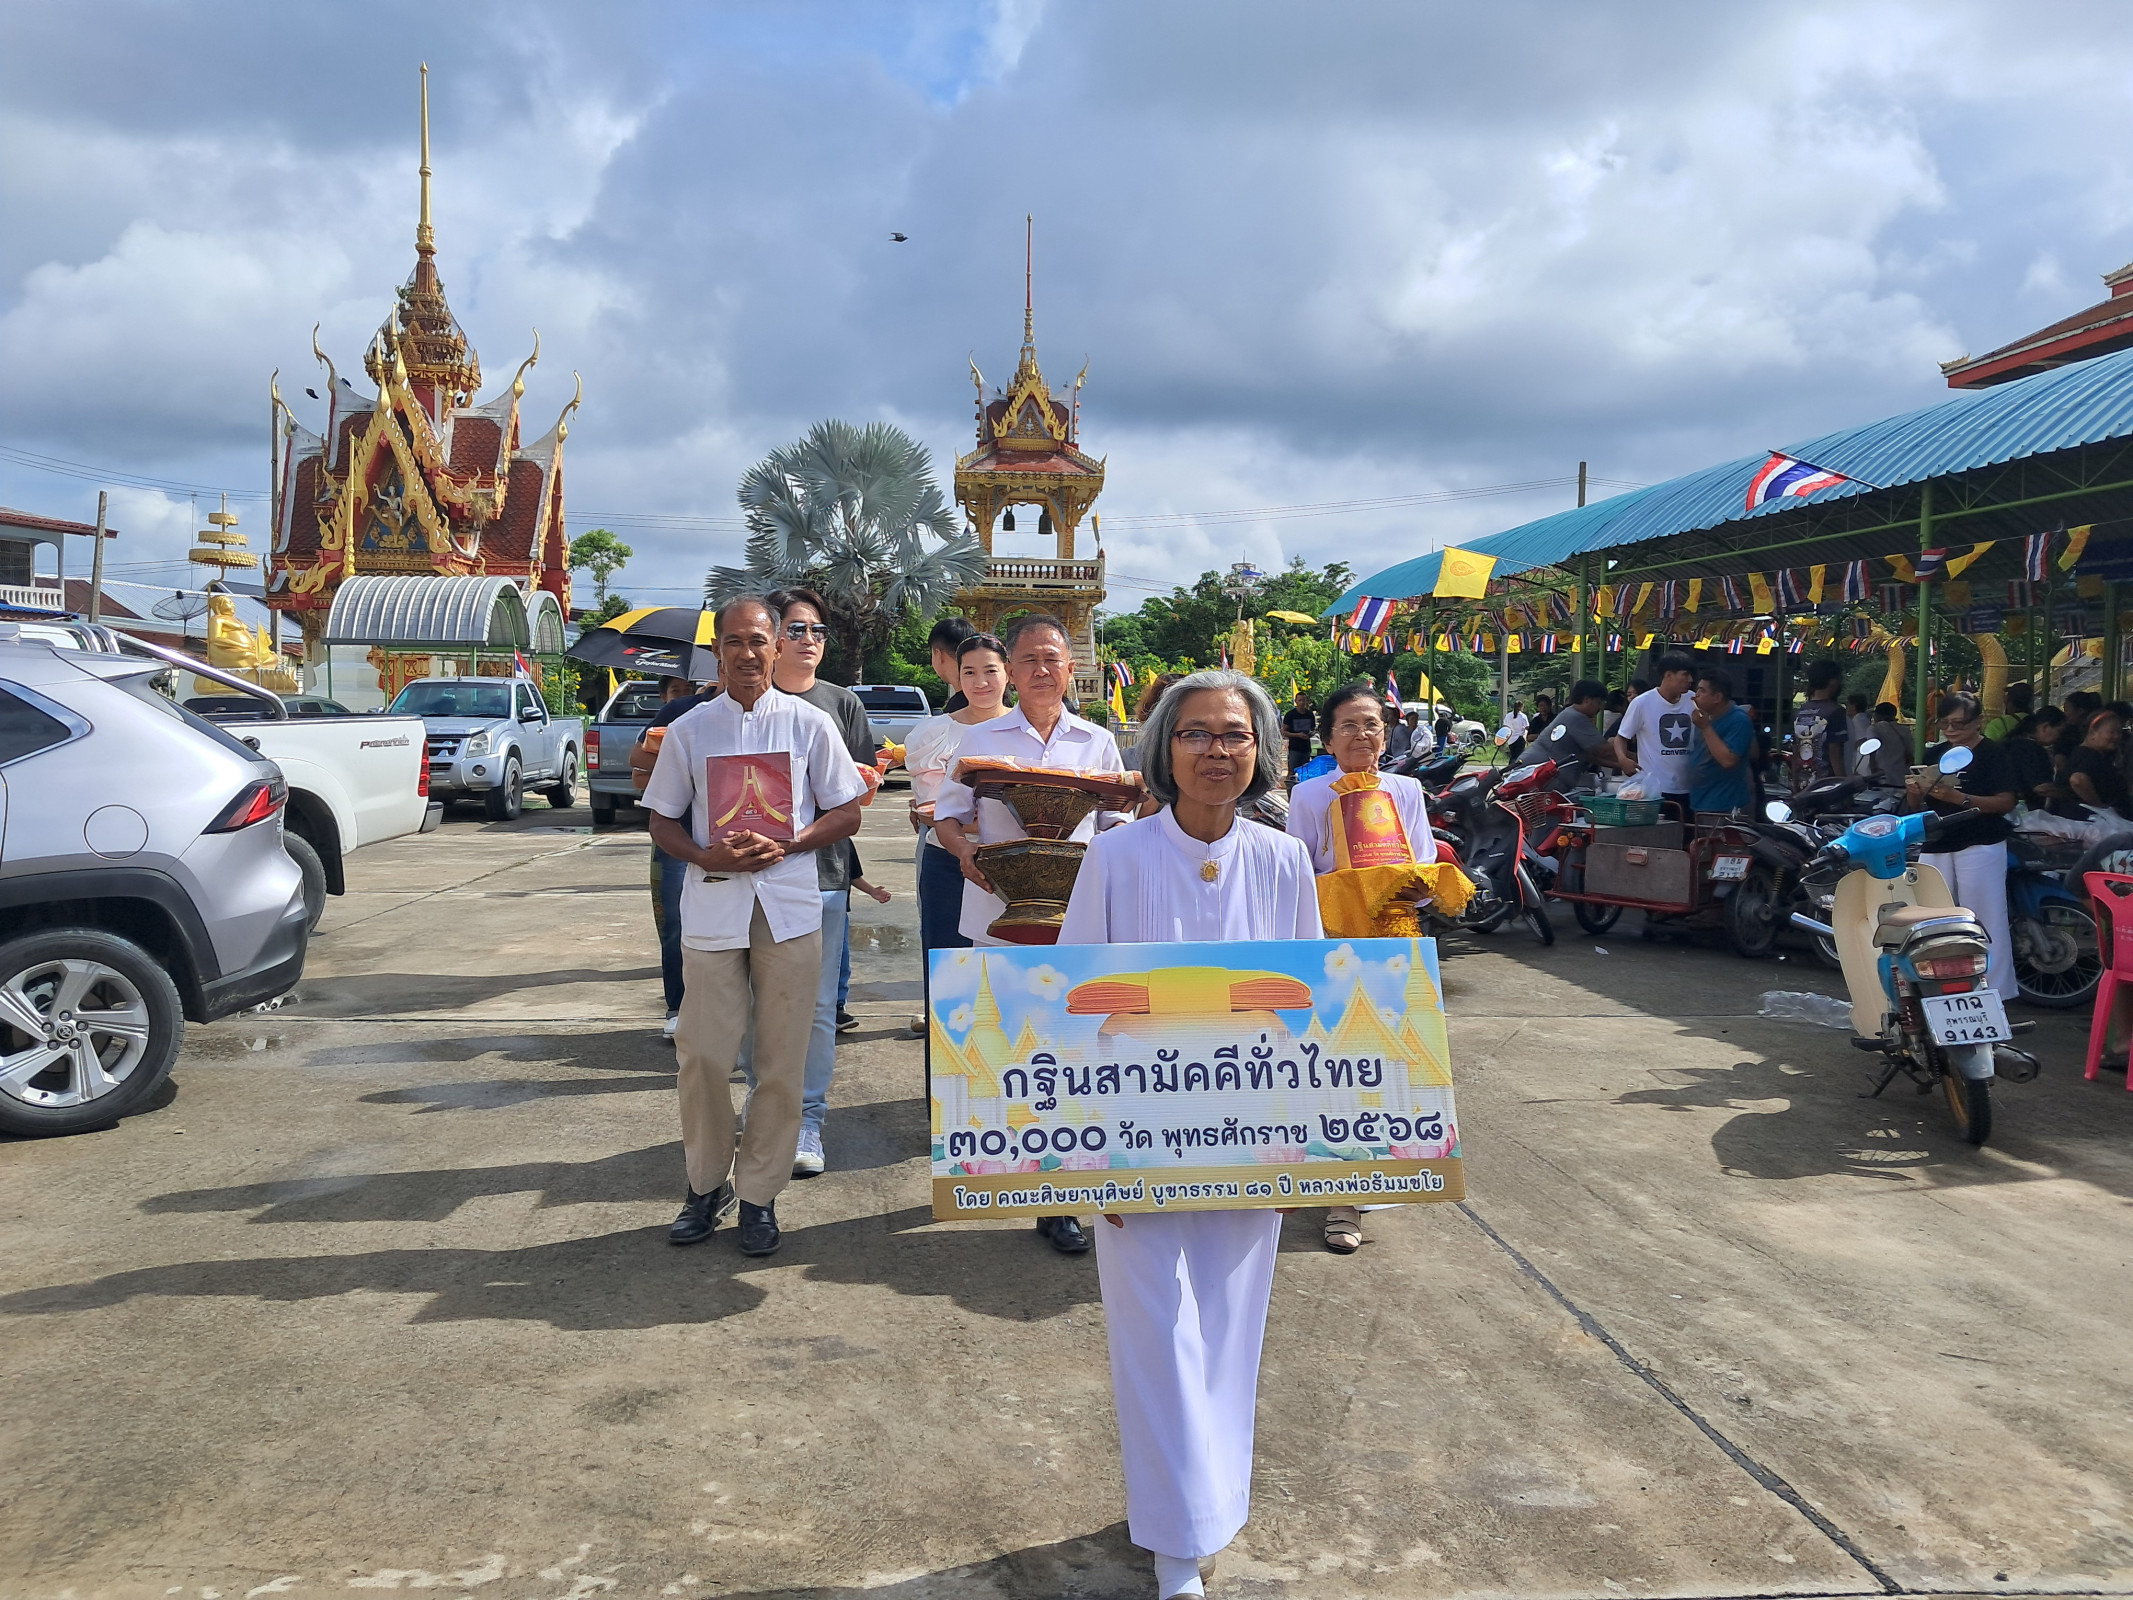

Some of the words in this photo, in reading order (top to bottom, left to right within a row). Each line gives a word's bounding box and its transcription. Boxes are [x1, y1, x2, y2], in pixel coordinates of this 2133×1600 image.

[634, 658, 681, 669] TaylorMade
[1945, 1011, 1989, 1028] สุพรรณบุรี
[1944, 1026, 1999, 1042] 9143
[1002, 1033, 1383, 1111] กฐินสามัคคีทั่วไทย
[949, 1125, 1107, 1161] ๓๐,๐๐๐
[1118, 1120, 1153, 1149] วัด
[1161, 1117, 1308, 1158] พุทธศักราช
[1318, 1111, 1443, 1143] ๒๕๖๘
[955, 1187, 990, 1208] โดย
[998, 1179, 1144, 1209] คณะศิษยานุศิษย์
[1151, 1181, 1238, 1205] บูชาธรรม
[1245, 1183, 1272, 1197] ๘๑
[1279, 1172, 1292, 1195] ปี
[1298, 1171, 1443, 1195] หลวงพ่อธัมมชโย
